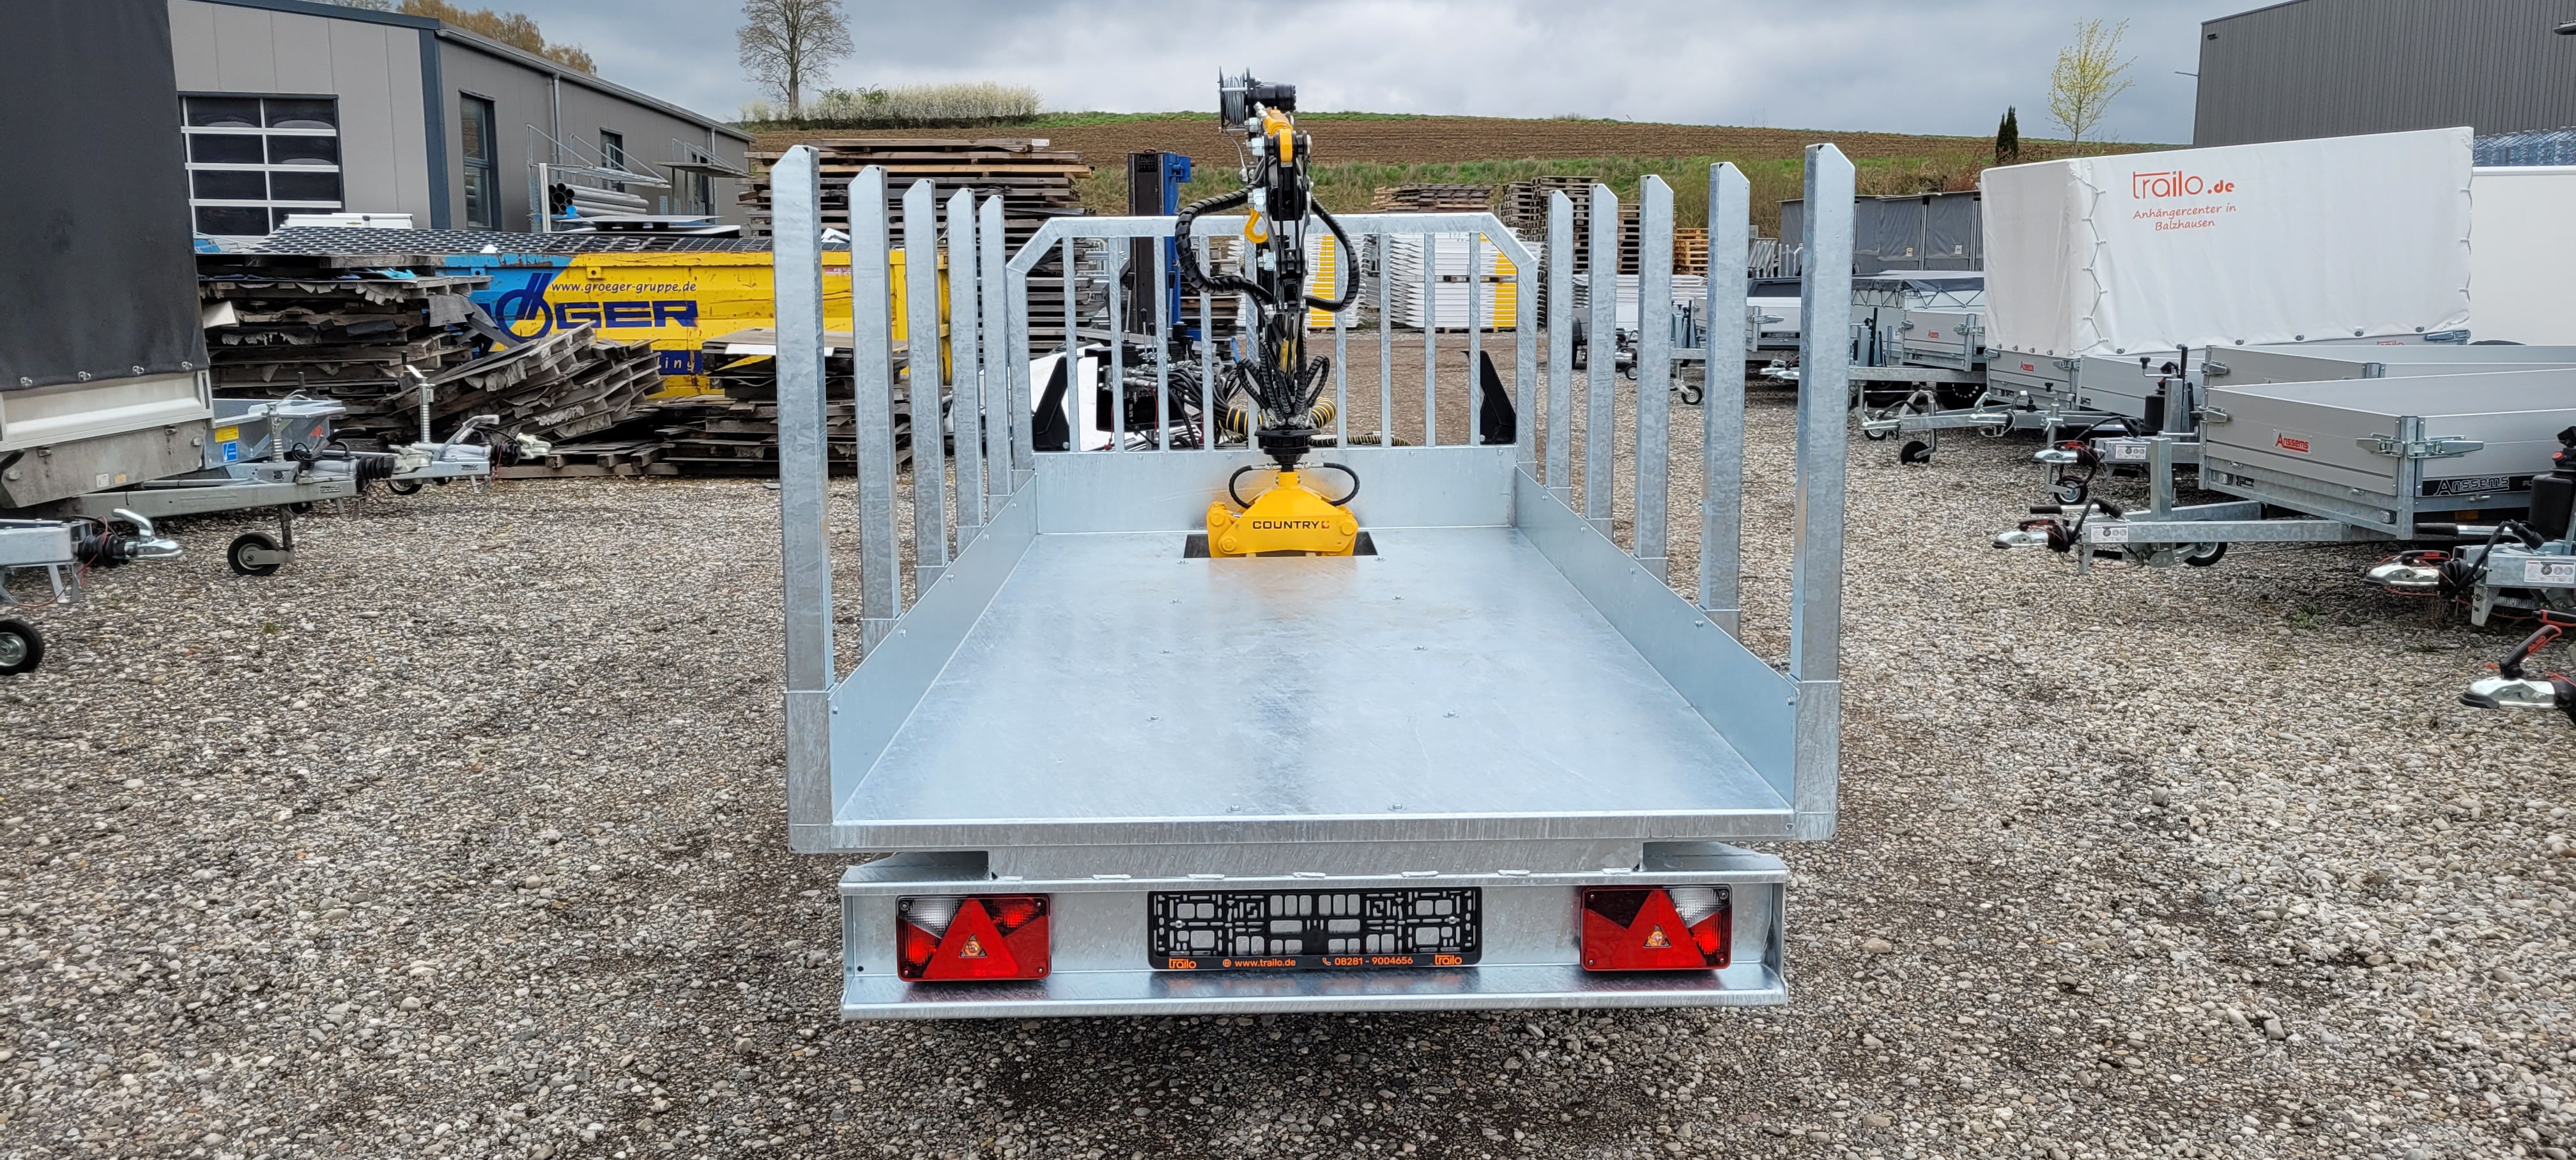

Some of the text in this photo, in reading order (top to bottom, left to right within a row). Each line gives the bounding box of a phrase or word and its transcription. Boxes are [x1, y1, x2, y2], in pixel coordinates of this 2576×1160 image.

[2133, 202, 2237, 220] Anhängercenter in
[2155, 219, 2215, 231] Balzhausen
[551, 280, 697, 294] www.groeger-gruppe.de
[2274, 432, 2309, 453] Anssems
[2433, 477, 2510, 496] Anssems
[1252, 521, 1320, 530] COUNTRY
[1169, 958, 1197, 969] trailo
[1234, 958, 1296, 967] www.trailo.de
[1334, 957, 1363, 966] 08281
[1371, 956, 1414, 965] 9004656
[1434, 954, 1463, 965] trailo
